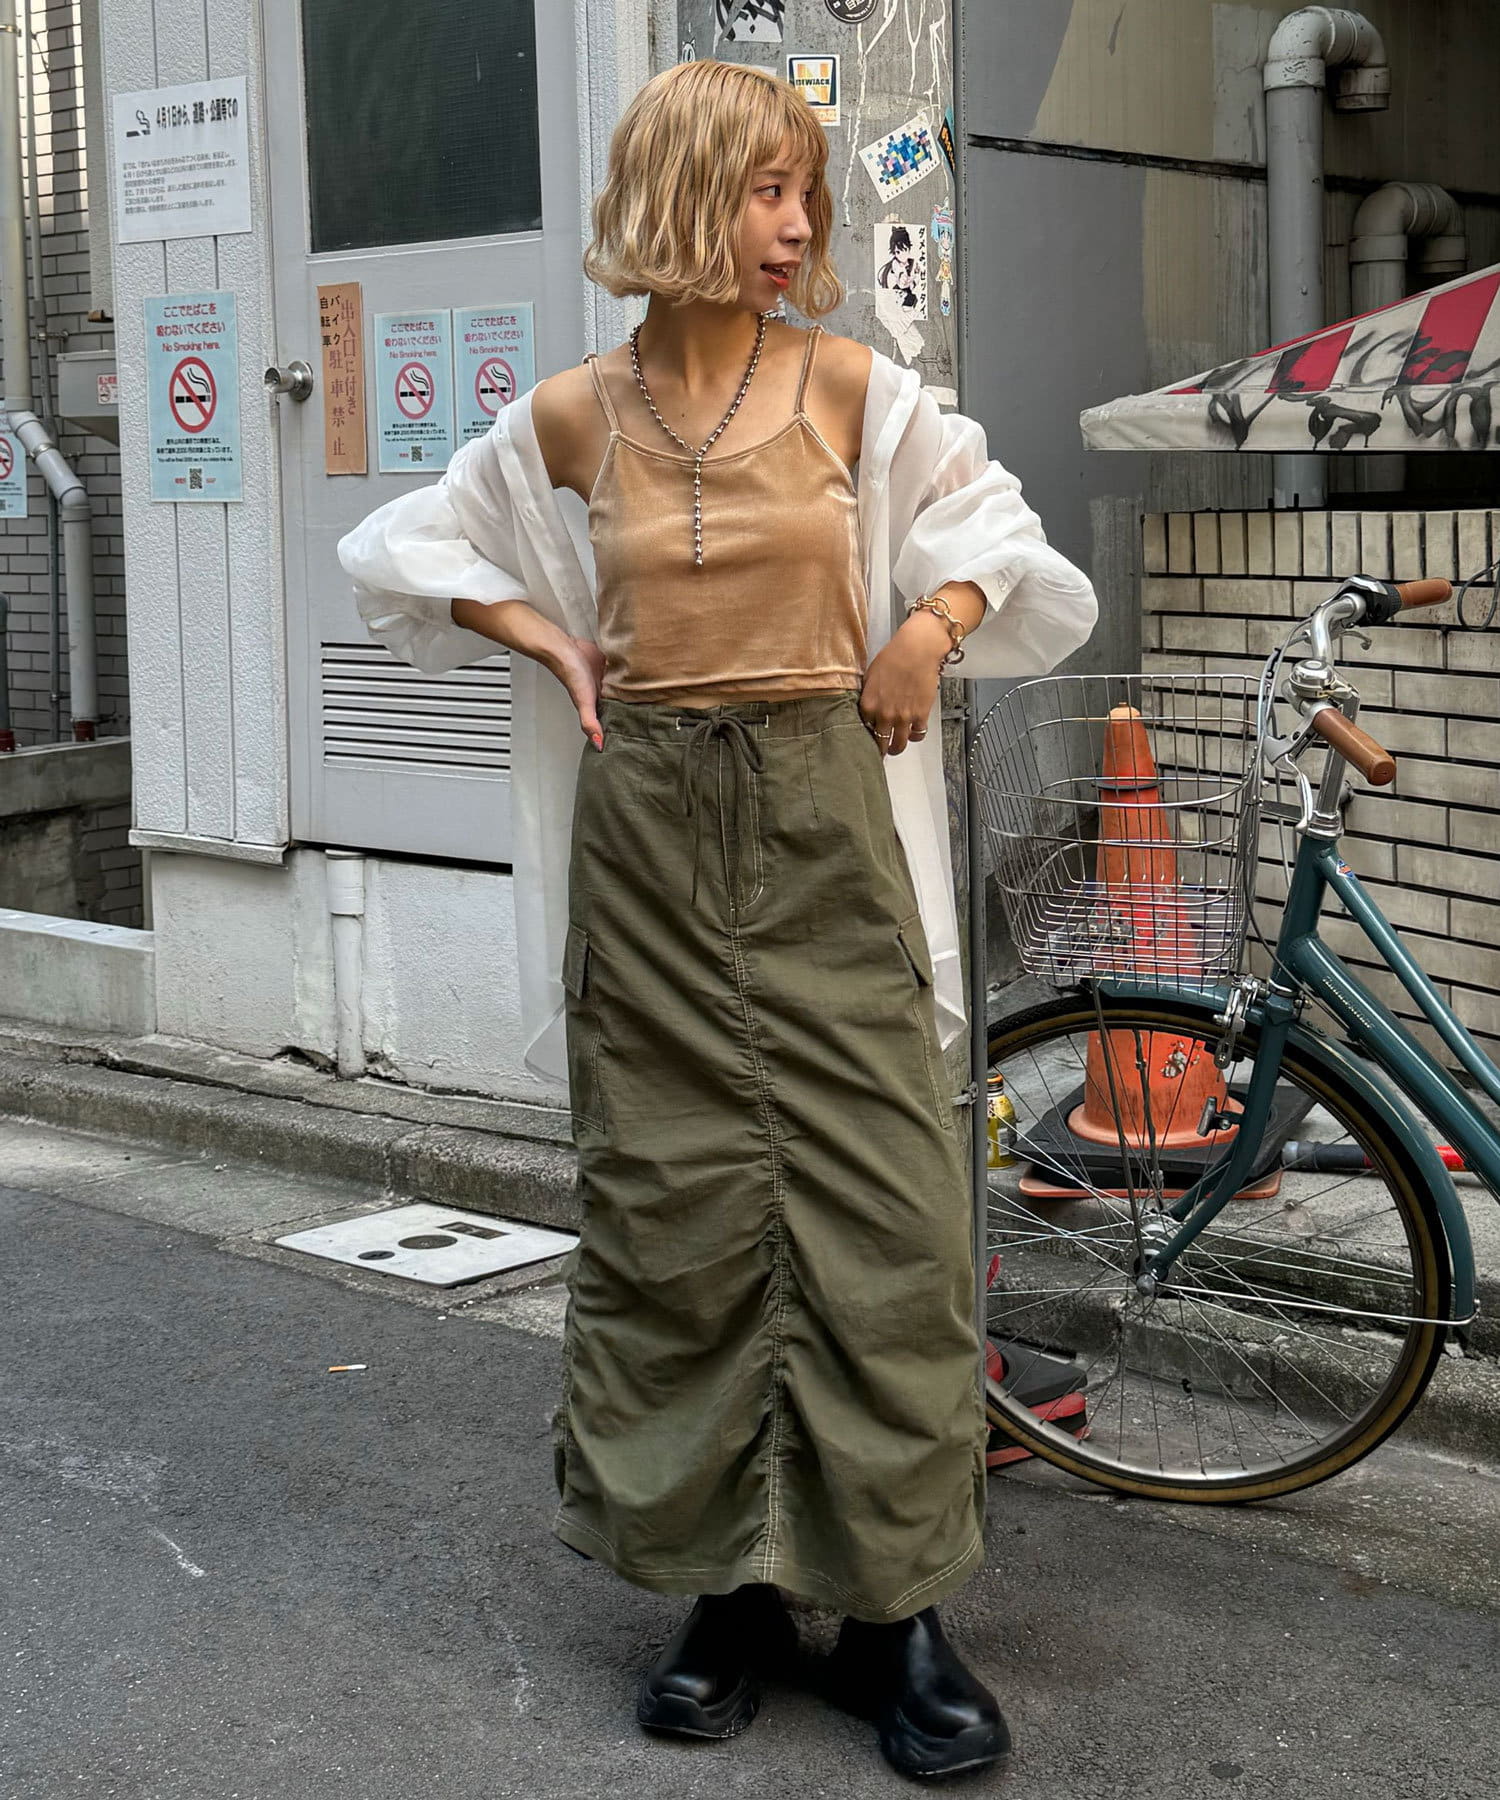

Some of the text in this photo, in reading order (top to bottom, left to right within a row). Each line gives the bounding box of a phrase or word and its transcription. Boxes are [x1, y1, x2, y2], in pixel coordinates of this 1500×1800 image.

[164, 303, 216, 317] ここでたばこを
[320, 297, 332, 347] 自転車
[330, 295, 341, 345] バイク
[471, 316, 517, 328] ここでたばこを
[156, 322, 226, 337] 吸わないでください
[391, 322, 435, 333] ここでたばこを
[385, 336, 441, 347] 吸わないでください
[464, 330, 524, 342] 吸わないでください
[162, 343, 173, 352] No
[174, 342, 202, 351] Smoking
[469, 346, 479, 354] No
[479, 345, 504, 353] Smoking
[399, 350, 424, 358] Smoking
[329, 350, 346, 455] 駐車禁止
